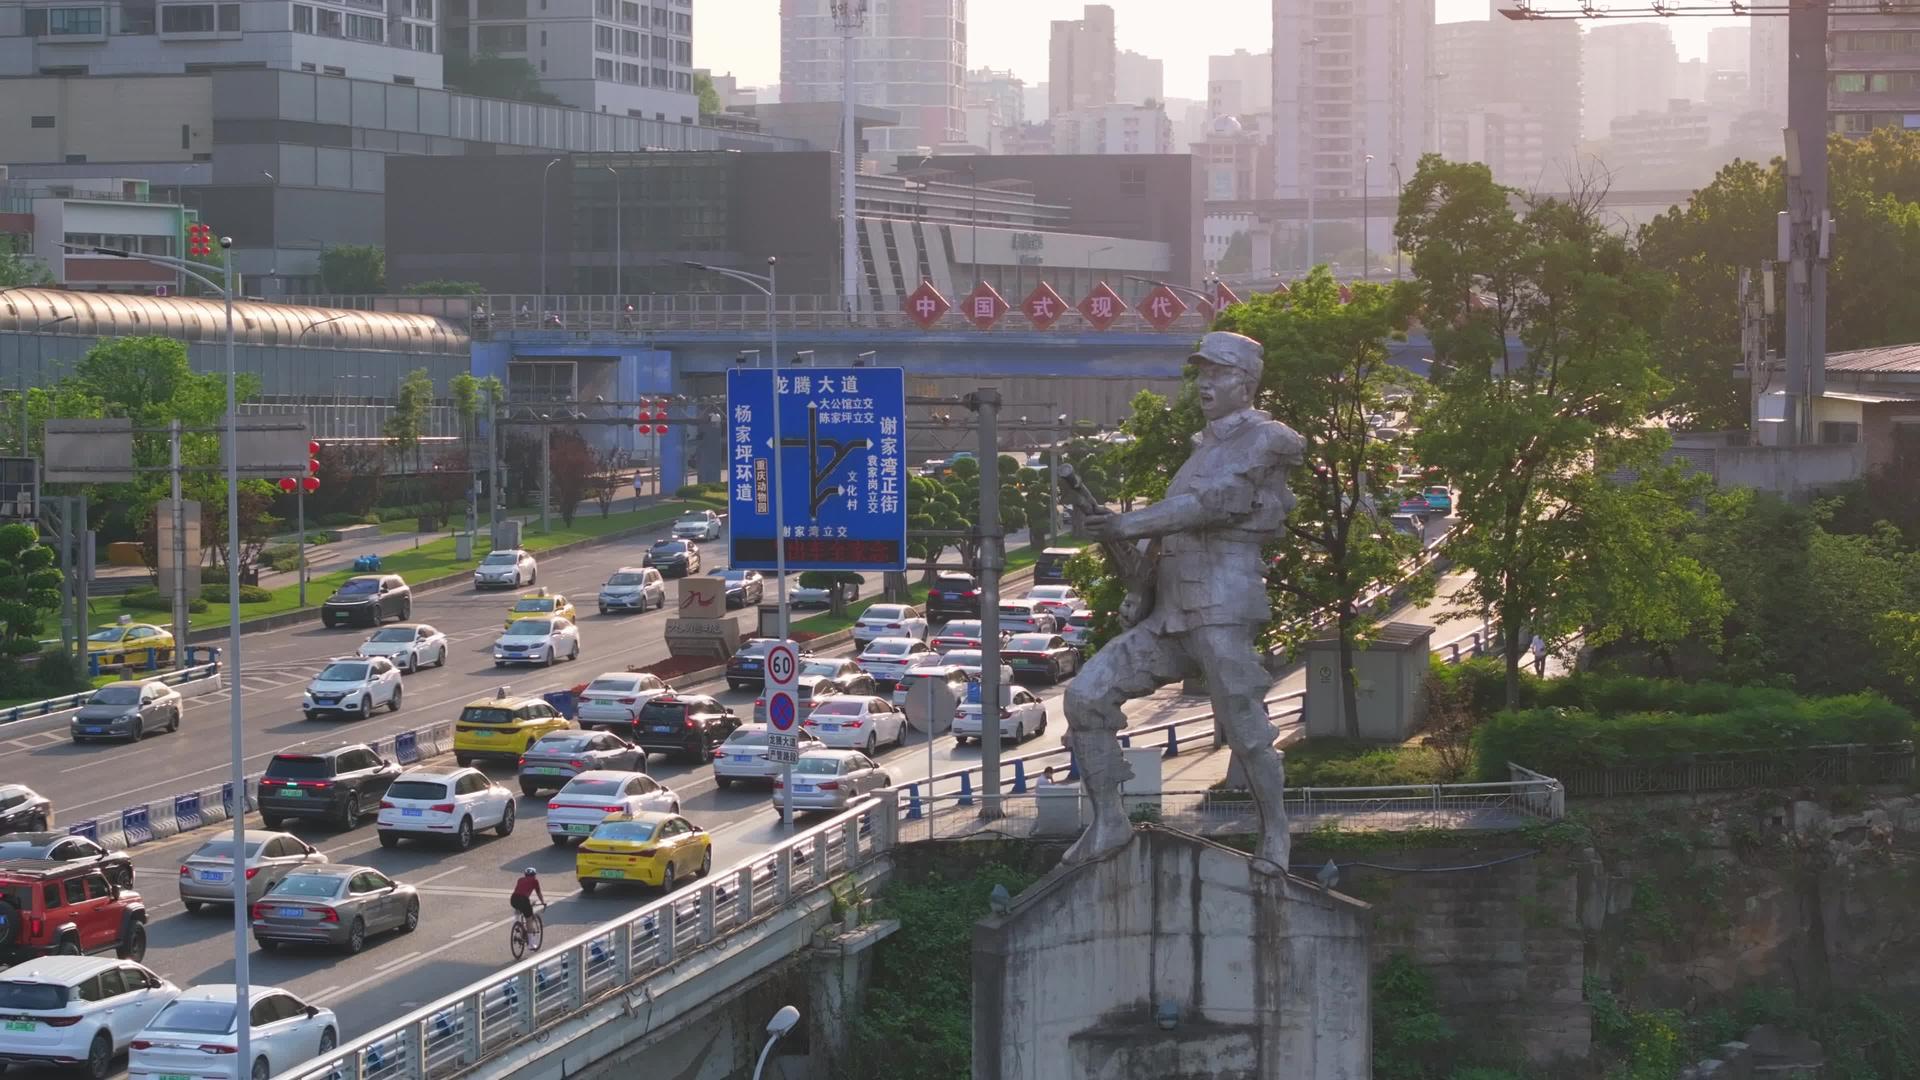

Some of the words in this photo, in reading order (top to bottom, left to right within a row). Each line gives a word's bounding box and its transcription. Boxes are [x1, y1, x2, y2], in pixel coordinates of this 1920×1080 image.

[776, 375, 859, 395] 龙腾大道
[819, 398, 874, 410] 大公馆立交
[819, 412, 875, 425] 陈家坪立交
[735, 405, 753, 502] 杨家坪环道
[880, 416, 898, 514] 谢家湾正街
[756, 459, 768, 514] 重庆动物园
[847, 470, 858, 512] 文化村
[867, 455, 878, 514] 袁家岗立交
[773, 656, 791, 674] 60
[769, 735, 796, 748] 龙腾大道
